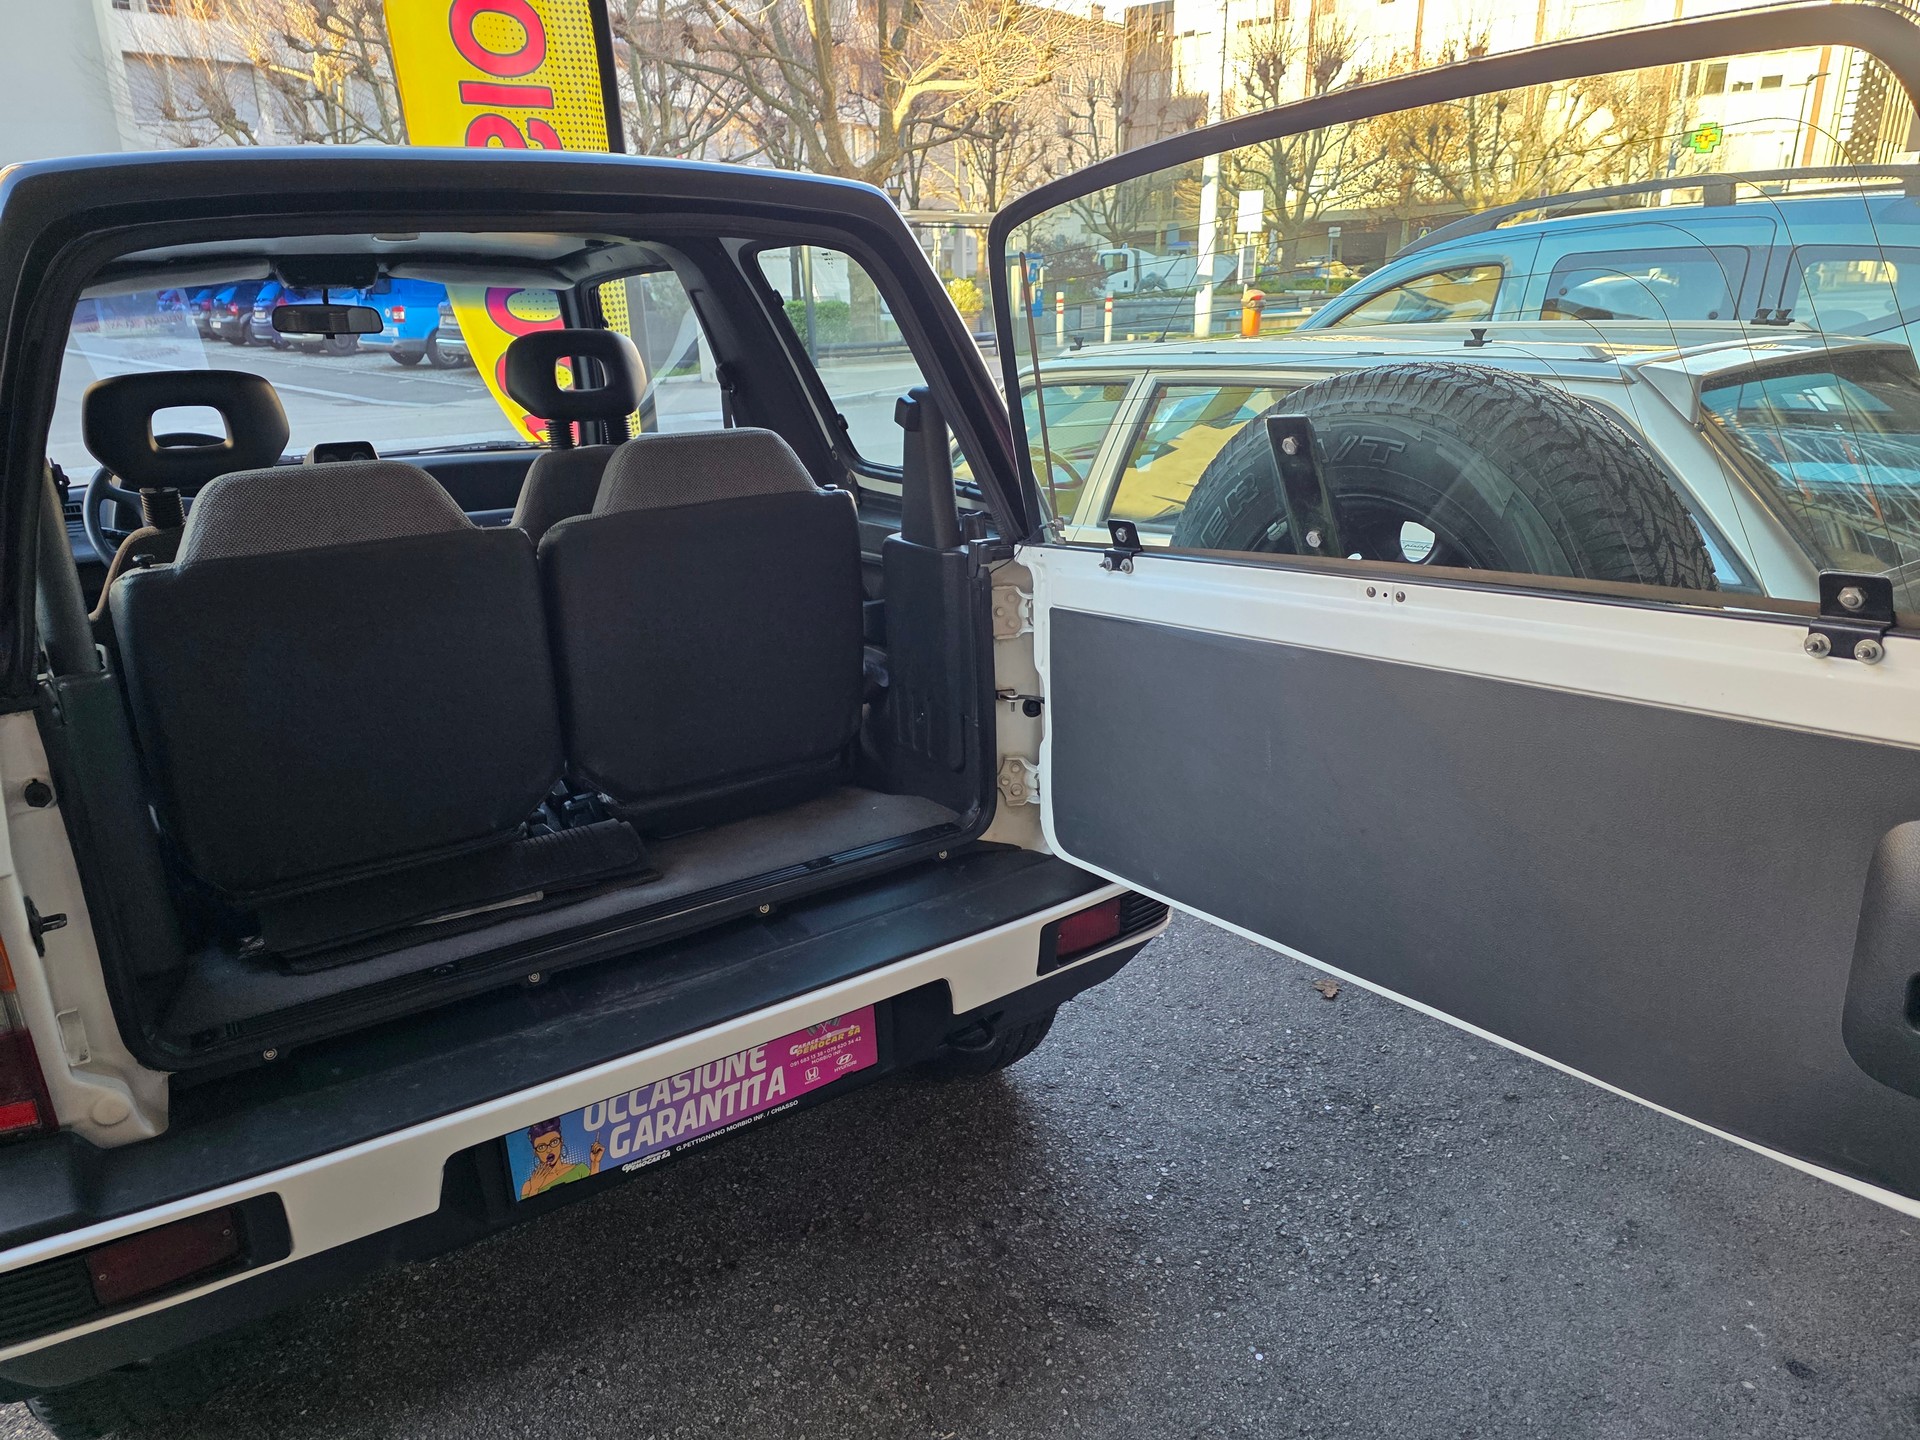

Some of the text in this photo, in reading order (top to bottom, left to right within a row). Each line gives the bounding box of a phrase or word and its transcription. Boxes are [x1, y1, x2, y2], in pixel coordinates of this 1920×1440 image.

[796, 1027, 860, 1057] PEMOCAR SA
[811, 1053, 832, 1065] MORBIO
[583, 1043, 768, 1132] OCCASIONE
[609, 1066, 786, 1159] GARANTITA
[726, 1117, 753, 1132] MORBIO
[753, 1113, 766, 1122] INF.
[770, 1099, 799, 1115] CHIASSO
